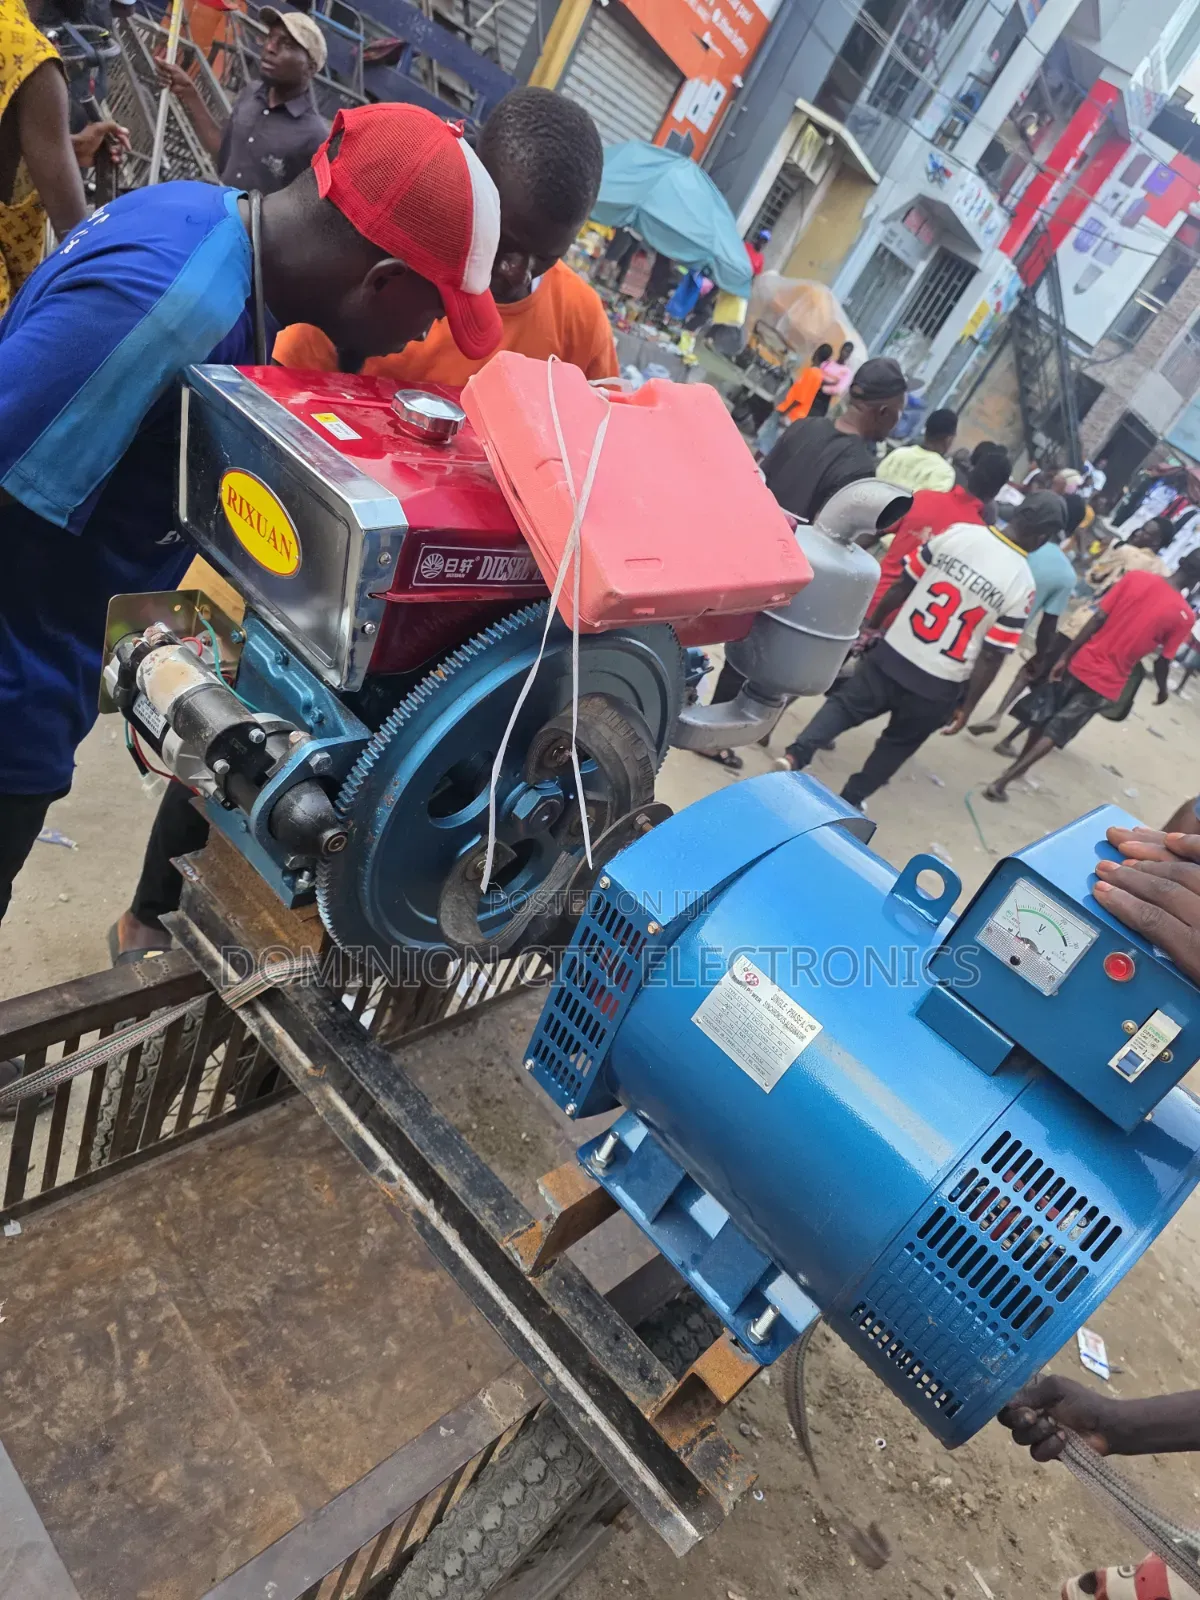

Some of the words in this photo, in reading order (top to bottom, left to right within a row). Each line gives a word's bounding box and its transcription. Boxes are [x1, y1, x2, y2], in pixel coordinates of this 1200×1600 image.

[226, 484, 294, 561] RIXUAN
[444, 556, 474, 575] 日轩
[476, 552, 530, 585] DIESEL
[910, 581, 987, 664] 31
[1036, 923, 1046, 933] V
[762, 1000, 787, 1024] SYNCHRONOUS
[783, 1020, 806, 1042] ALTERNATOR
[769, 992, 788, 1010] SINGLE
[786, 1007, 803, 1024] PHASE
